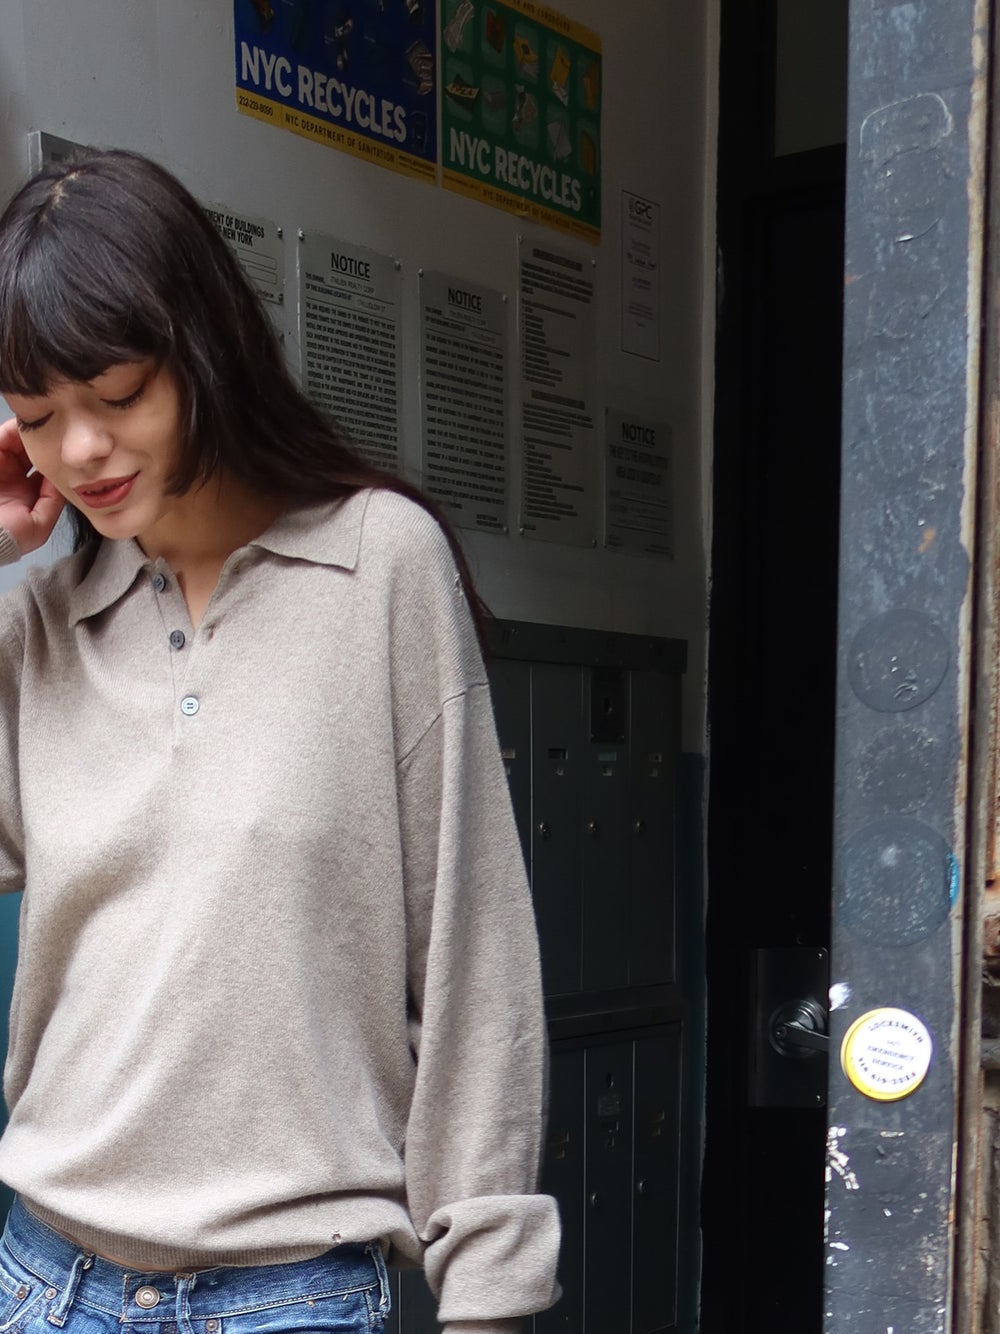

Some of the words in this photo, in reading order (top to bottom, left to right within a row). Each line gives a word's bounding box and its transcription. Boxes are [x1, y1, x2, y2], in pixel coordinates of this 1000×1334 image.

[241, 41, 292, 97] NYC
[298, 65, 407, 142] RECYCLES
[285, 112, 300, 128] NYC
[301, 118, 346, 145] DEPARTMENT
[347, 133, 357, 149] OF
[358, 137, 396, 163] SANITATION
[450, 128, 491, 173] NYC
[495, 146, 581, 212] RECYCLES
[225, 214, 234, 227] OF
[235, 217, 265, 238] BUILDINGS
[237, 232, 253, 246] YORK
[331, 252, 371, 278] NOTICE
[448, 288, 482, 311] NOTICE
[622, 422, 656, 446] NOTICE
